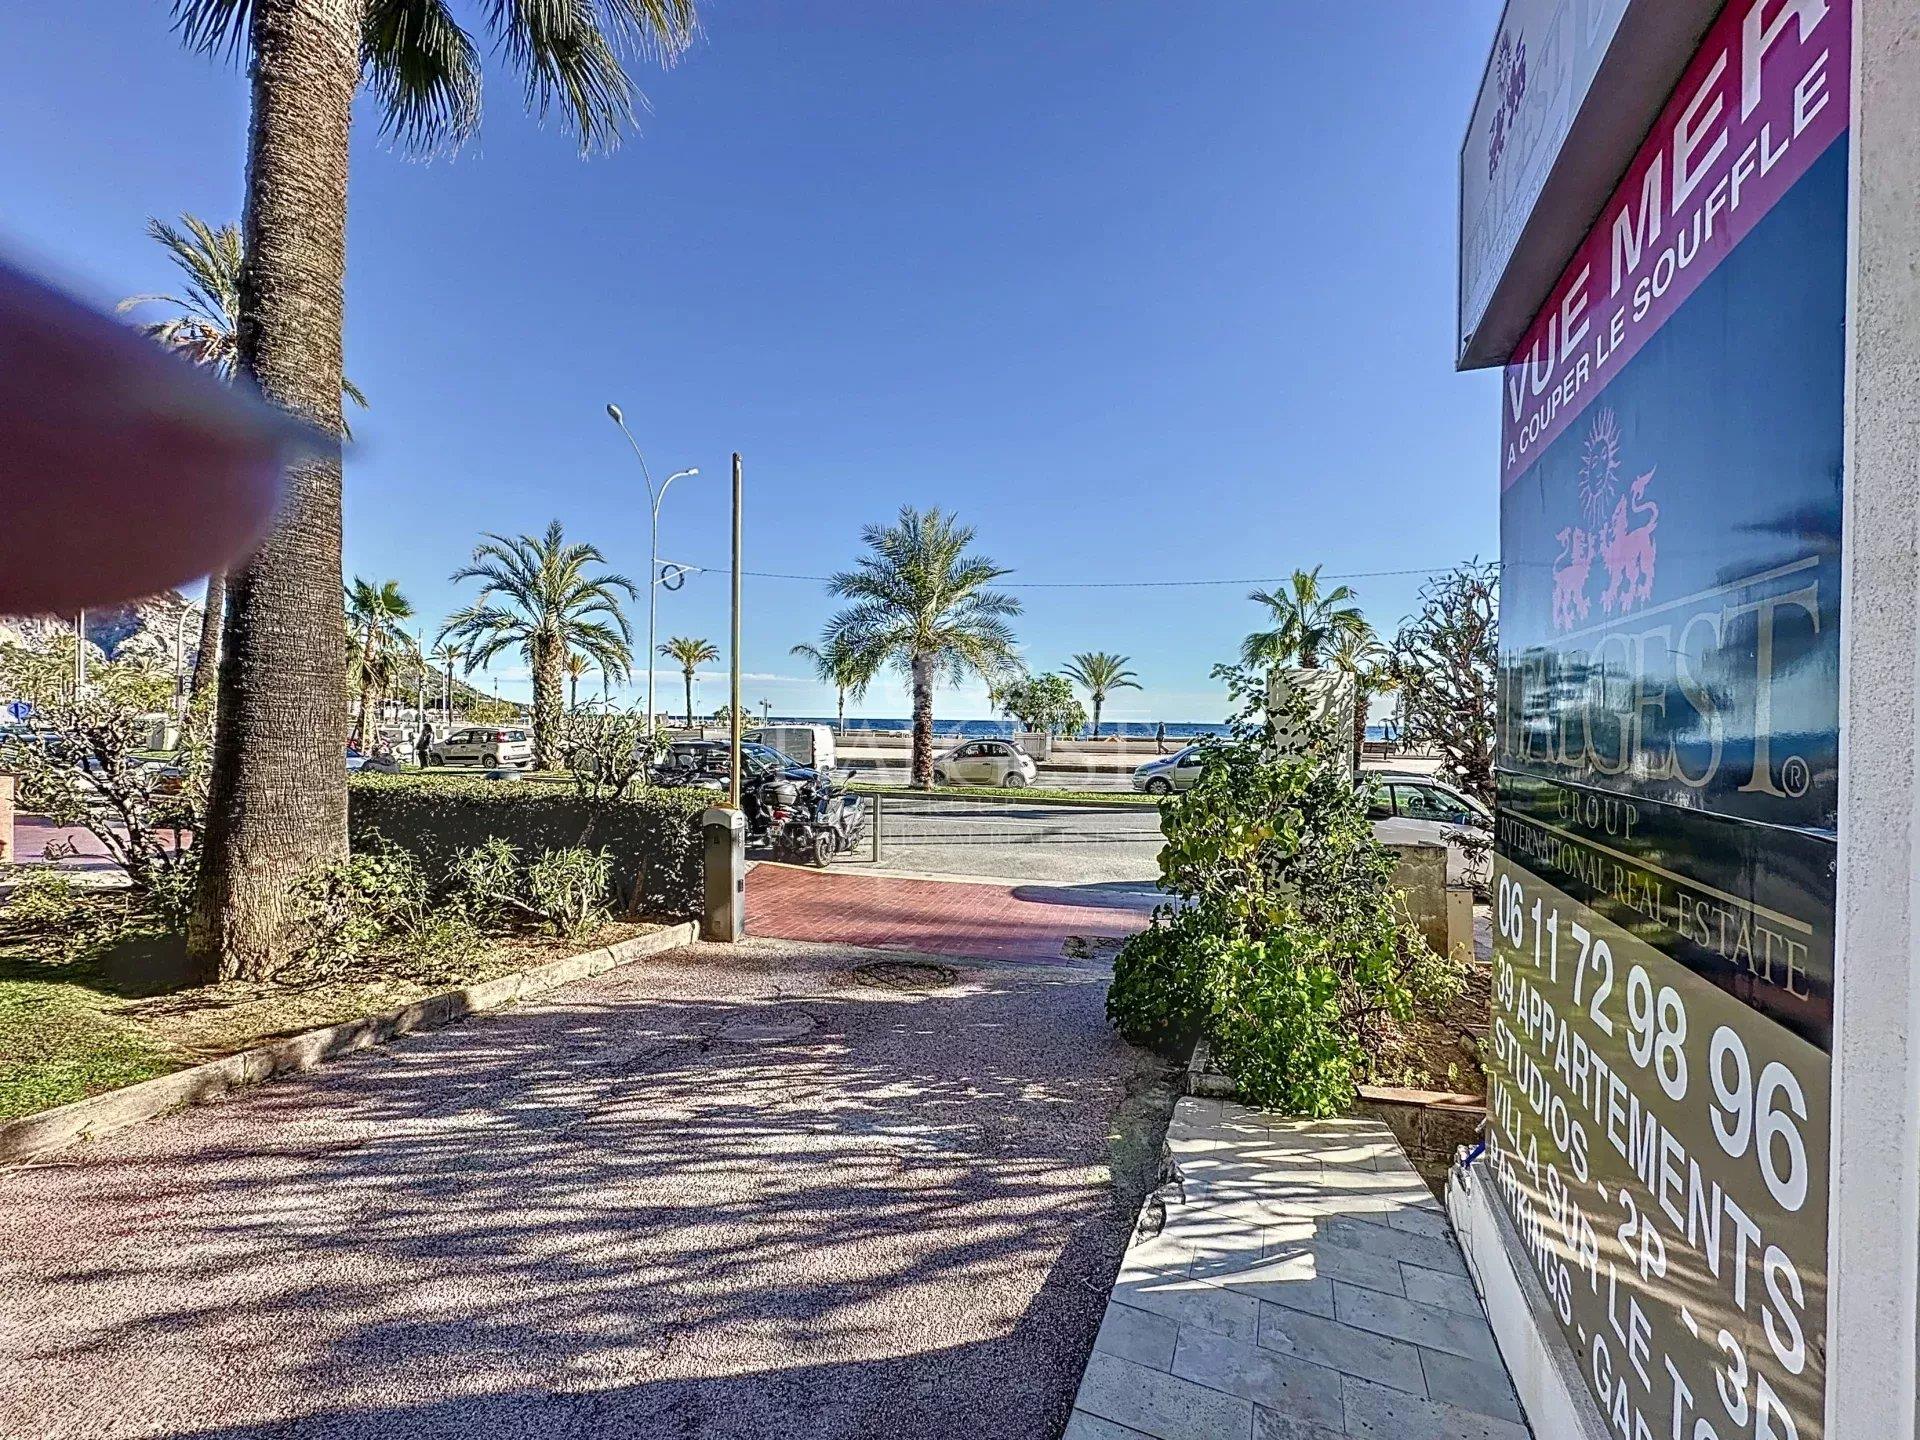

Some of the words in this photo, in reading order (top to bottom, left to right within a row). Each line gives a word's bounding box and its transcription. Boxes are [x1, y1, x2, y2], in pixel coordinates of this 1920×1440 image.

[1507, 442, 1517, 470] A
[1519, 352, 1590, 454] COUPER
[1596, 305, 1625, 370] LE
[1632, 48, 1830, 323] SOUFFLE
[1508, 262, 1590, 424] VUE
[1500, 816, 1608, 895] INTERNATIONAL
[1612, 864, 1669, 928] REAL
[1677, 892, 1810, 1002] ESTATE
[1558, 788, 1639, 841] GROUP
[1495, 1016, 1589, 1184] STUDIOS
[1617, 1188, 1667, 1283] 2P
[1498, 954, 1514, 1012] 39
[1517, 977, 1806, 1375] APPARTEMENTS
[1499, 873, 1523, 949] 06
[1531, 897, 1558, 984] 11
[1571, 921, 1613, 1038] 72
[1627, 964, 1689, 1101] 98
[1709, 1025, 1808, 1212] 96
[1491, 1129, 1572, 1326] PARKINGS
[1493, 1070, 1540, 1192] VILLA
[1546, 1163, 1599, 1296] SUR
[1608, 1260, 1652, 1394] LE
[1664, 1352, 1720, 1440] T
